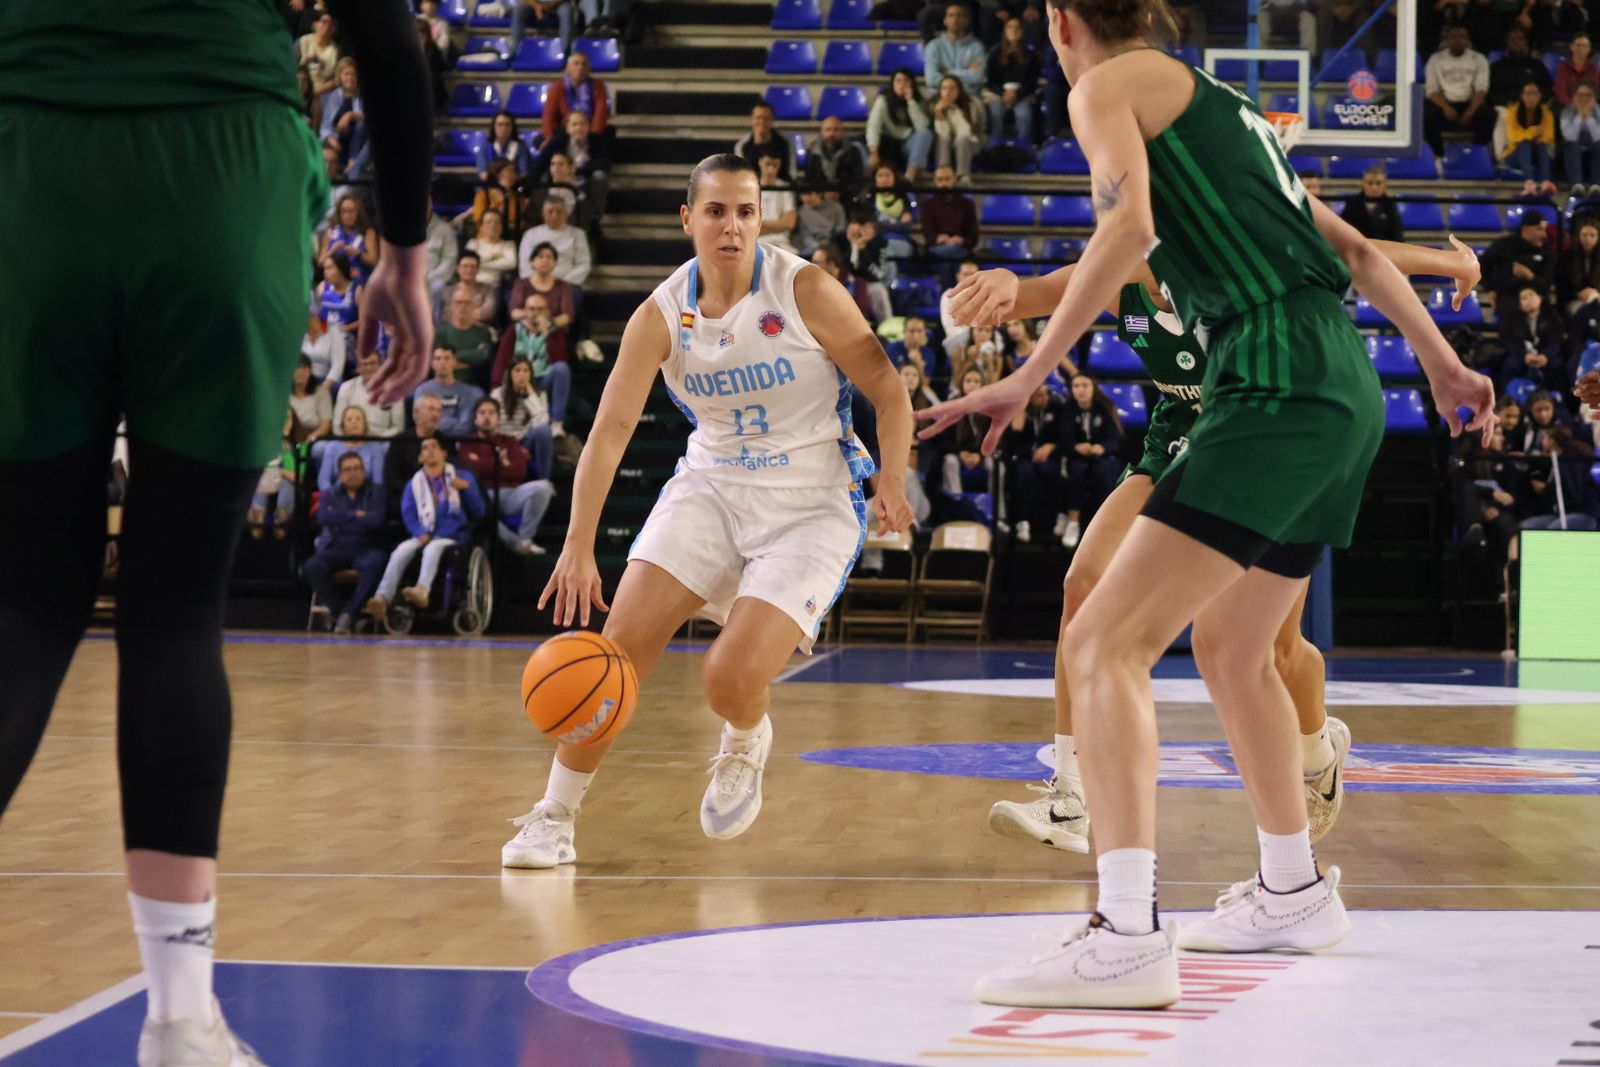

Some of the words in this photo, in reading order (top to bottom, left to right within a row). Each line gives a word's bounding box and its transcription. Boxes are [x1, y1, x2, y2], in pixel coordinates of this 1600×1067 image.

[1334, 104, 1393, 115] EUROCUP
[1339, 113, 1388, 126] WOMEN
[684, 357, 796, 398] AVENIDA
[729, 404, 769, 436] 13
